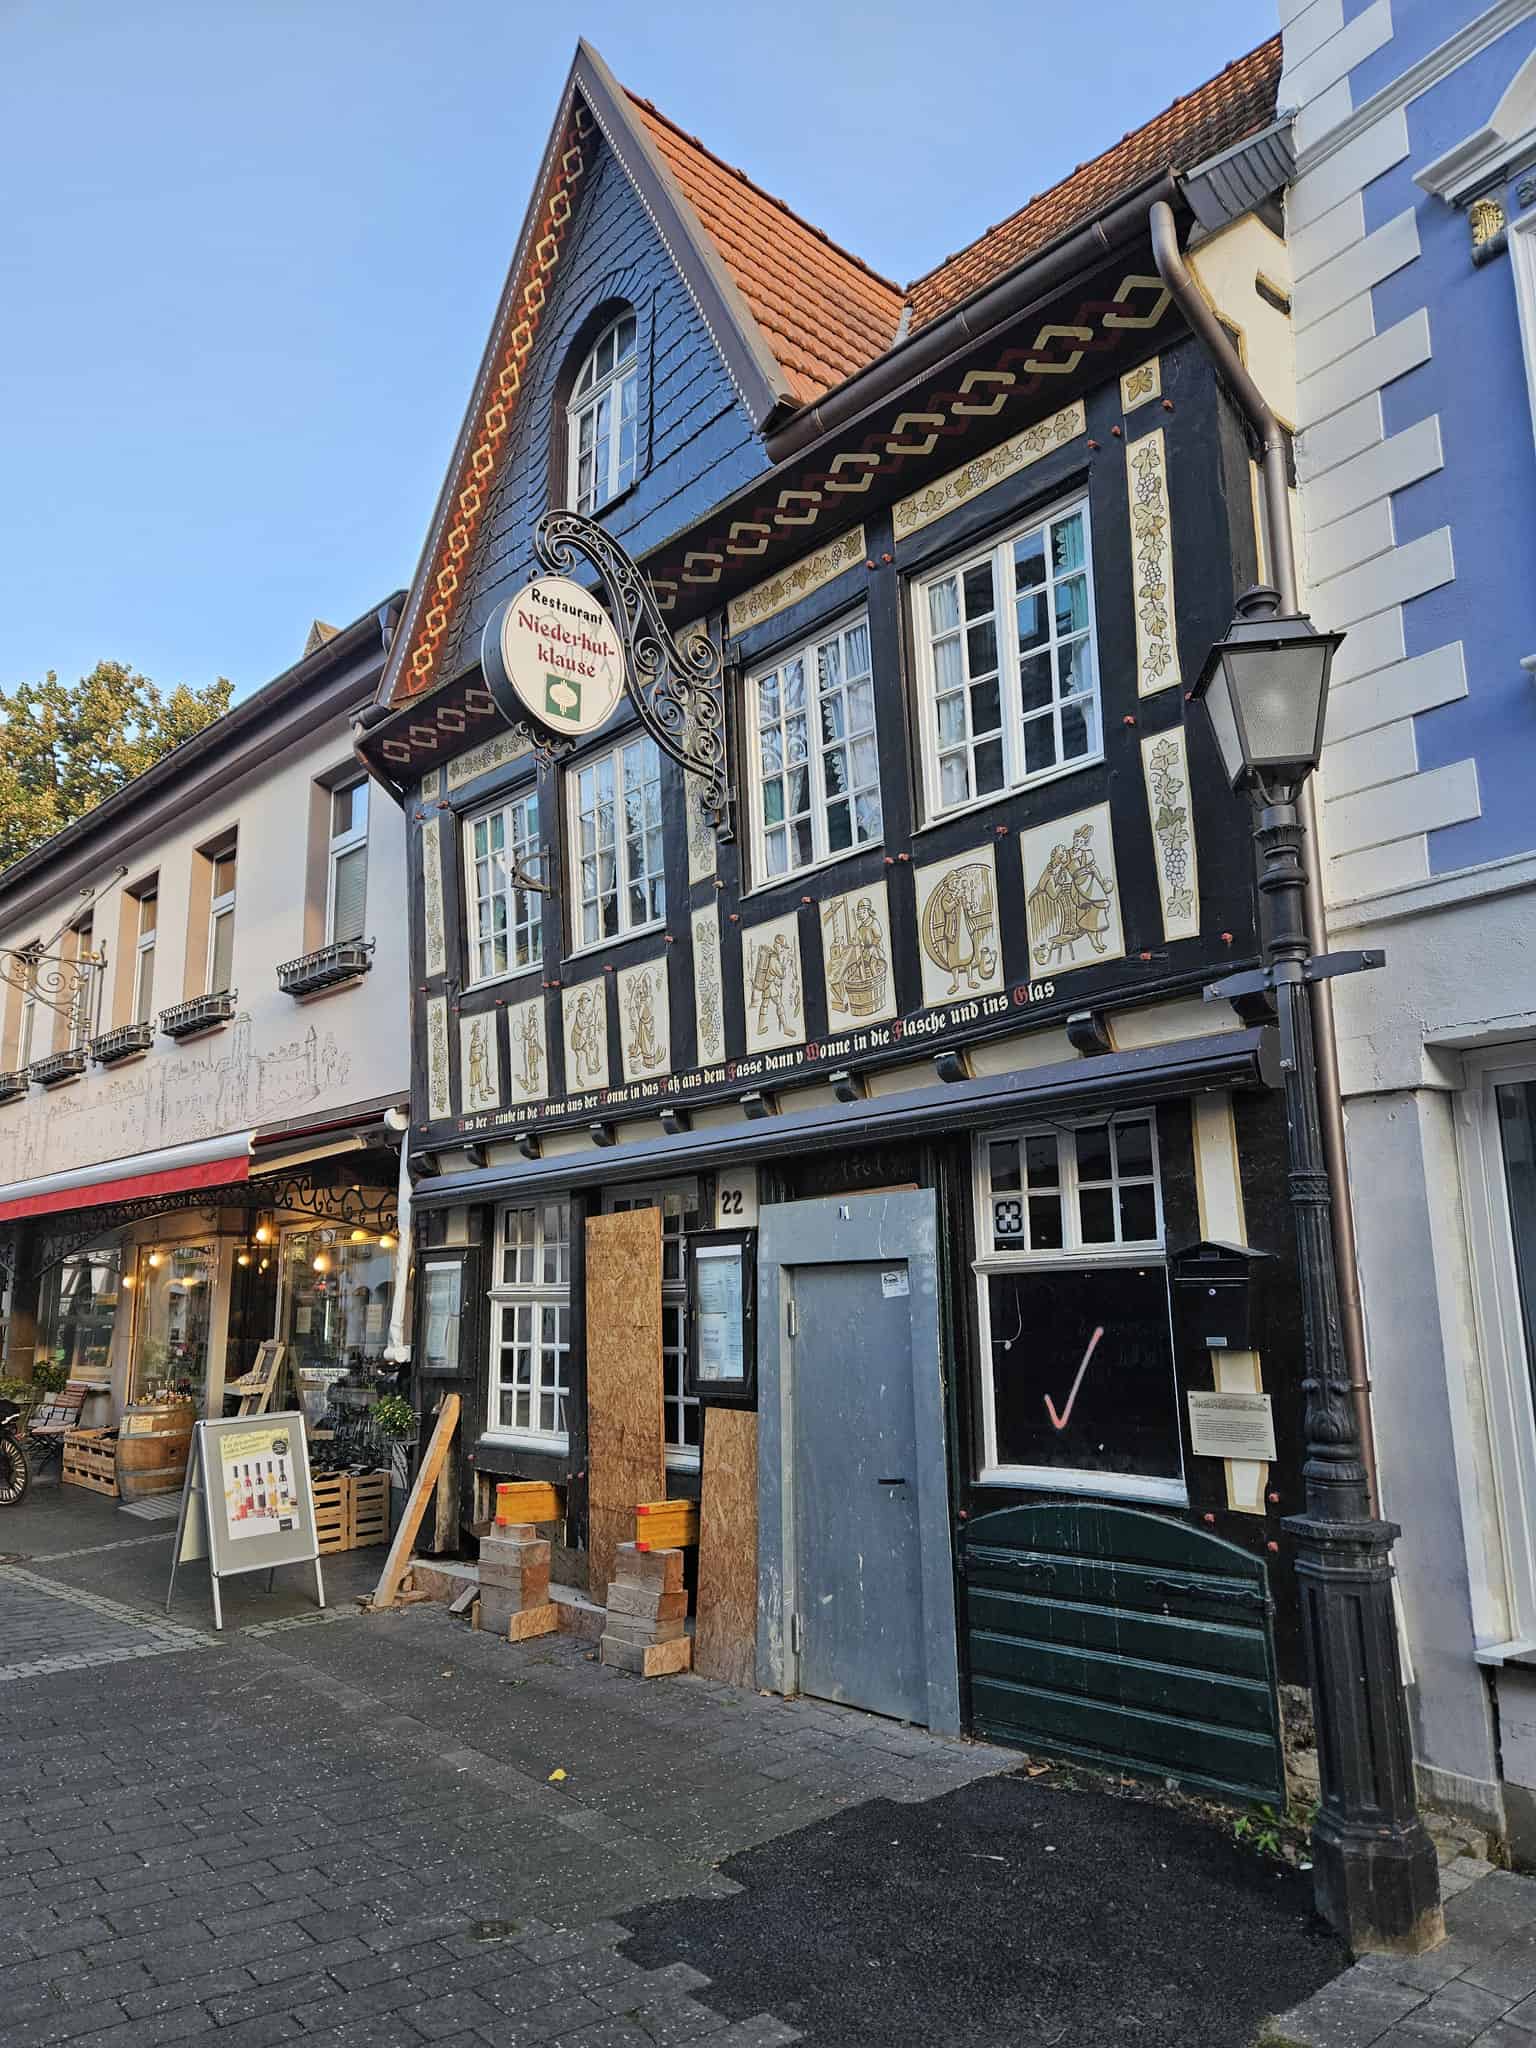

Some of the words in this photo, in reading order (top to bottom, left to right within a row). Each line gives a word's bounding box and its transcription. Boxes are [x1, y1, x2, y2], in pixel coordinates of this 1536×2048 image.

[530, 587, 604, 626] Restaurant
[517, 609, 616, 659] Niederhut-
[537, 643, 597, 679] klause
[475, 1115, 487, 1129] der
[516, 1107, 527, 1121] in
[527, 1105, 538, 1120] die
[567, 1098, 584, 1114] aus
[584, 1094, 599, 1110] der
[600, 1087, 628, 1105] Tonne
[630, 1085, 640, 1099] in
[642, 1081, 659, 1097] das
[682, 1073, 702, 1089] aus
[703, 1068, 726, 1085] dem
[764, 1052, 794, 1071] dann
[853, 1033, 868, 1052] in
[870, 1028, 890, 1048] die
[891, 1011, 947, 1042] Flasche
[950, 1001, 979, 1025] und
[982, 994, 1009, 1016] ins
[1012, 979, 1056, 1007] Glas
[721, 1189, 744, 1215] 22
